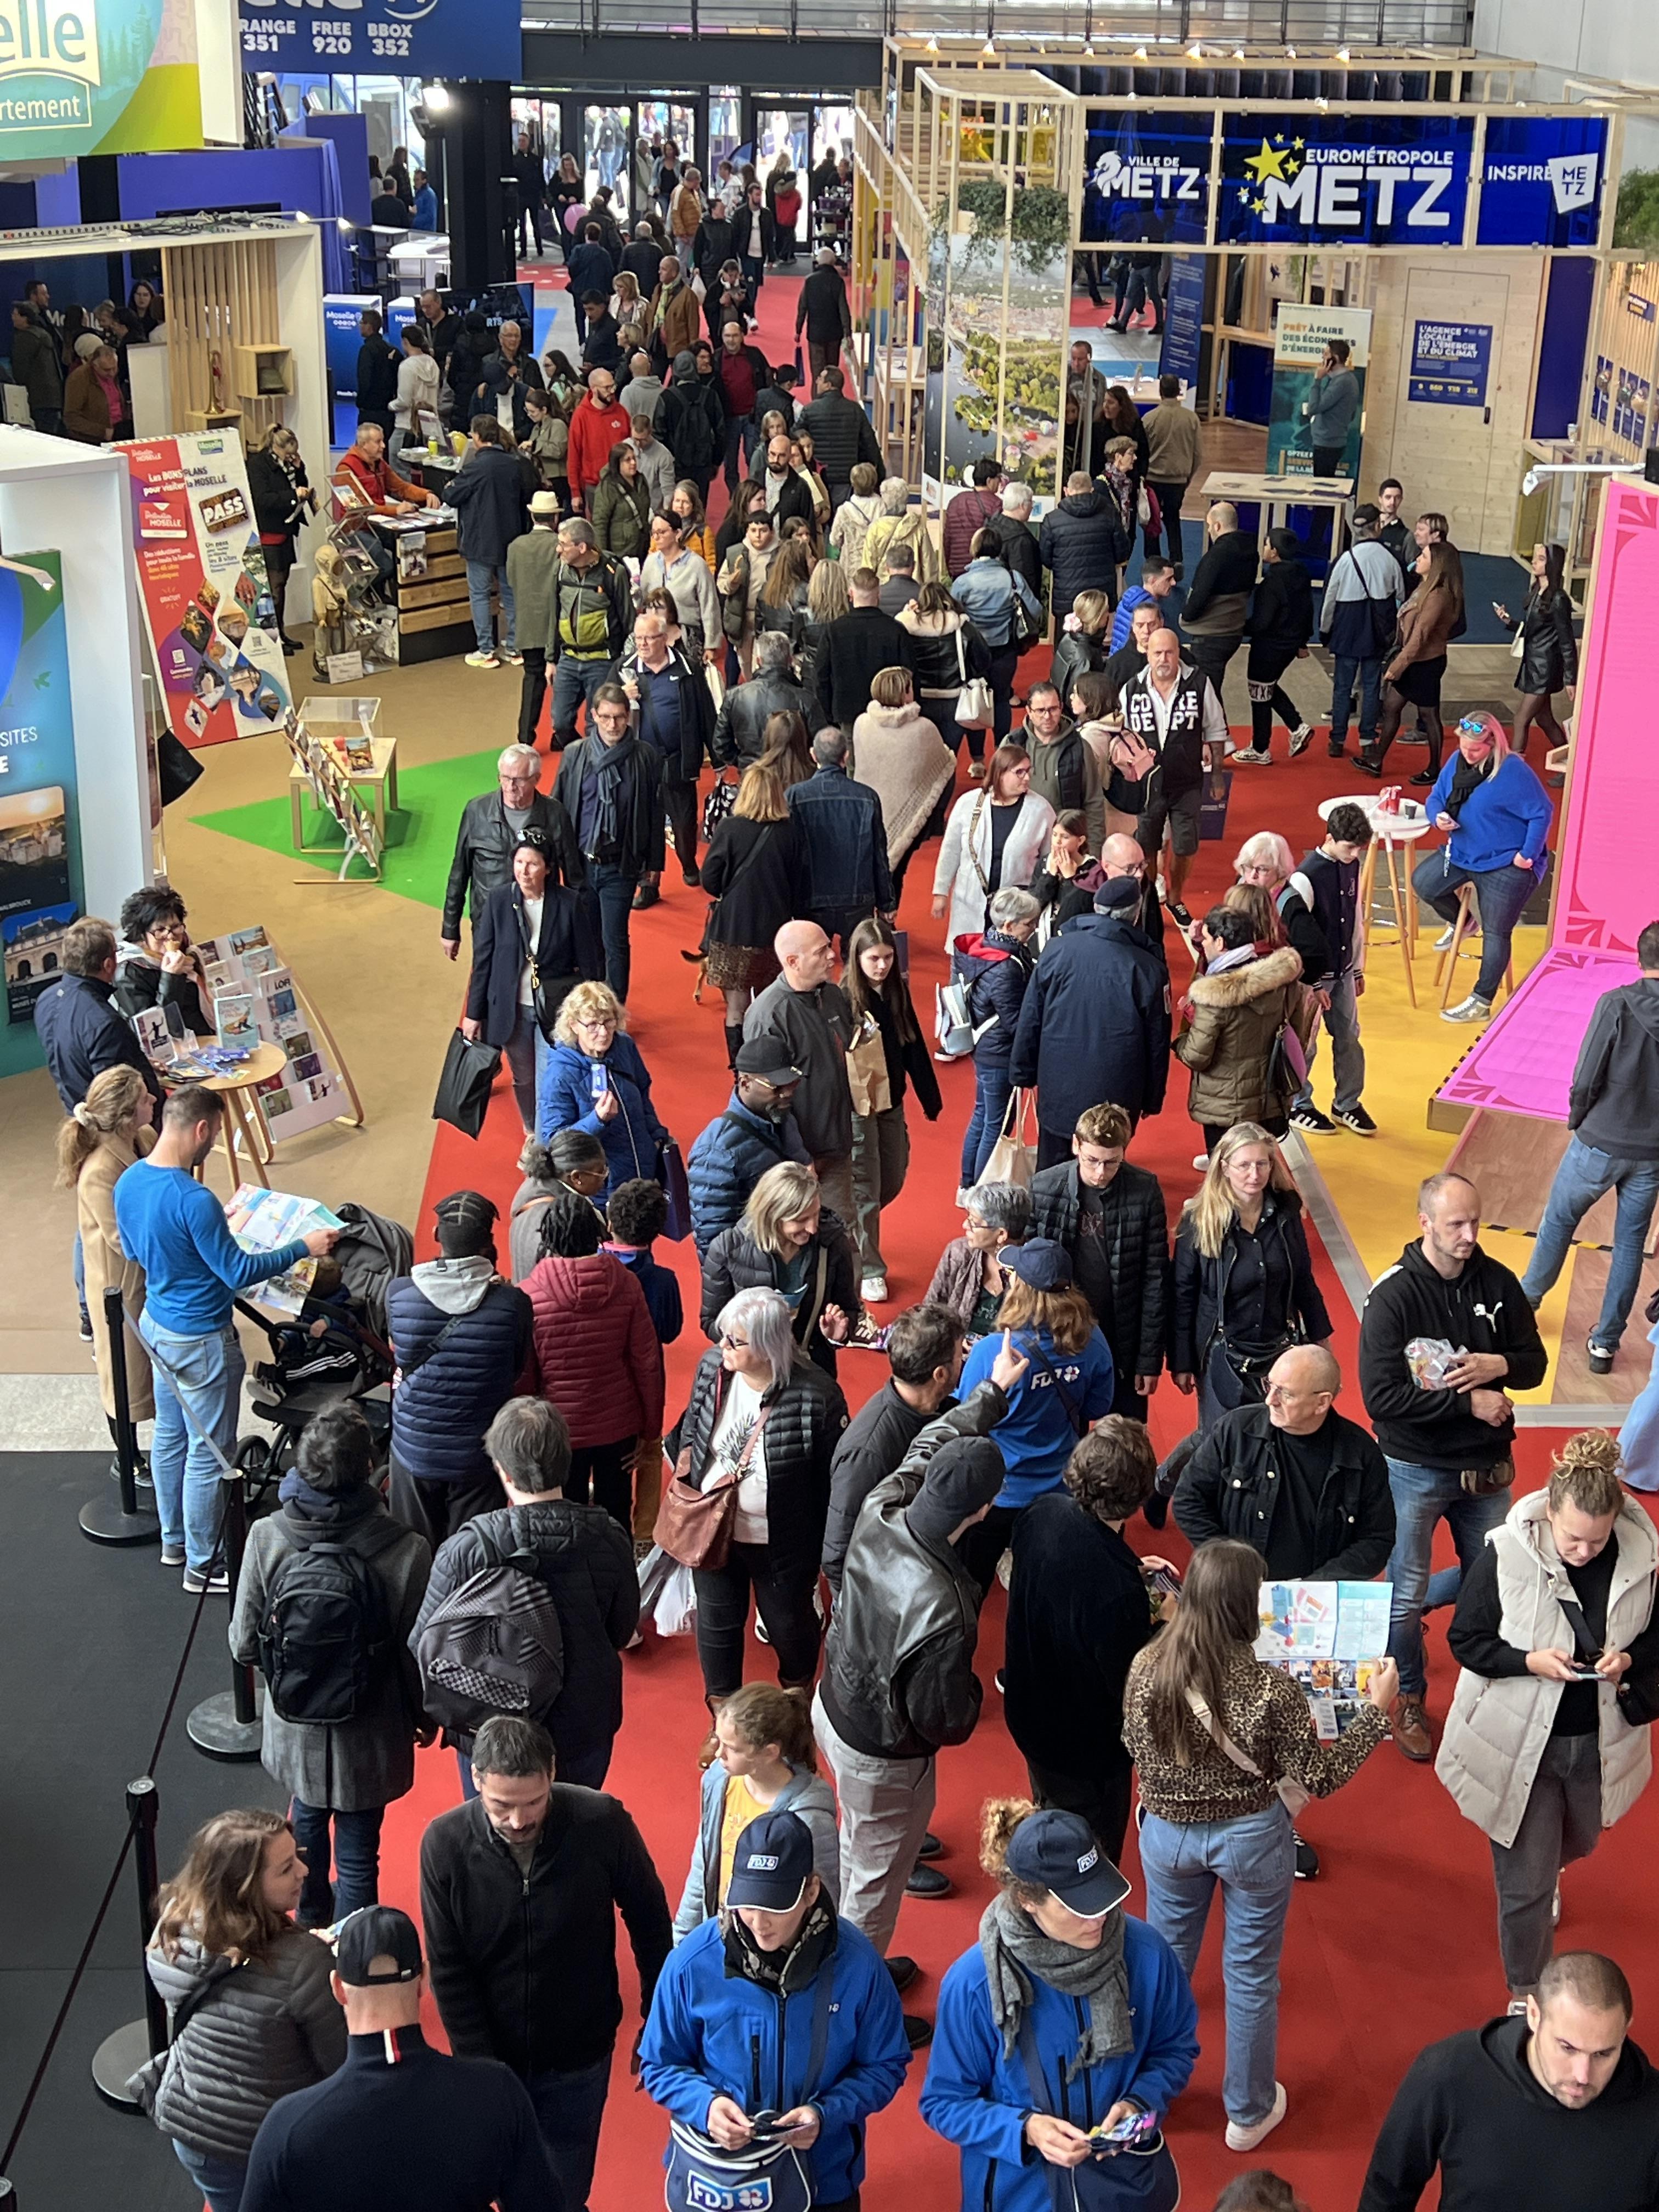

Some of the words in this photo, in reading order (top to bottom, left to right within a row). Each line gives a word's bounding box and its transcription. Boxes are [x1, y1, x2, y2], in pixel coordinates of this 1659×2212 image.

[312, 20, 352, 36] FREE
[367, 22, 413, 38] BBOX
[243, 34, 278, 52] 351
[312, 36, 352, 54] 920
[372, 38, 409, 56] 352
[1128, 156, 1161, 167] VILLE
[1163, 156, 1180, 167] DE
[1306, 146, 1453, 165] EUROMÉTROPOLE
[1488, 165, 1552, 181] INSPIRE
[1102, 166, 1200, 199] METZ
[1262, 165, 1453, 226] METZ
[1308, 323, 1315, 332] À
[1317, 326, 1343, 335] FAIRE
[1419, 333, 1453, 341] LOCALE
[1420, 325, 1462, 335] L'AGENCE
[1302, 334, 1356, 346] ÉCONES
[1445, 348, 1478, 358] CLIMAT
[148, 473, 161, 482] Les
[162, 469, 183, 479] BONS
[183, 466, 207, 477] PLANS
[143, 486, 161, 497] pour
[163, 482, 185, 492] visiter
[194, 475, 227, 487] MOSELLE
[203, 496, 244, 523] PASS
[0, 726, 38, 747] SITES
[693, 2180, 734, 2210] FDJ
